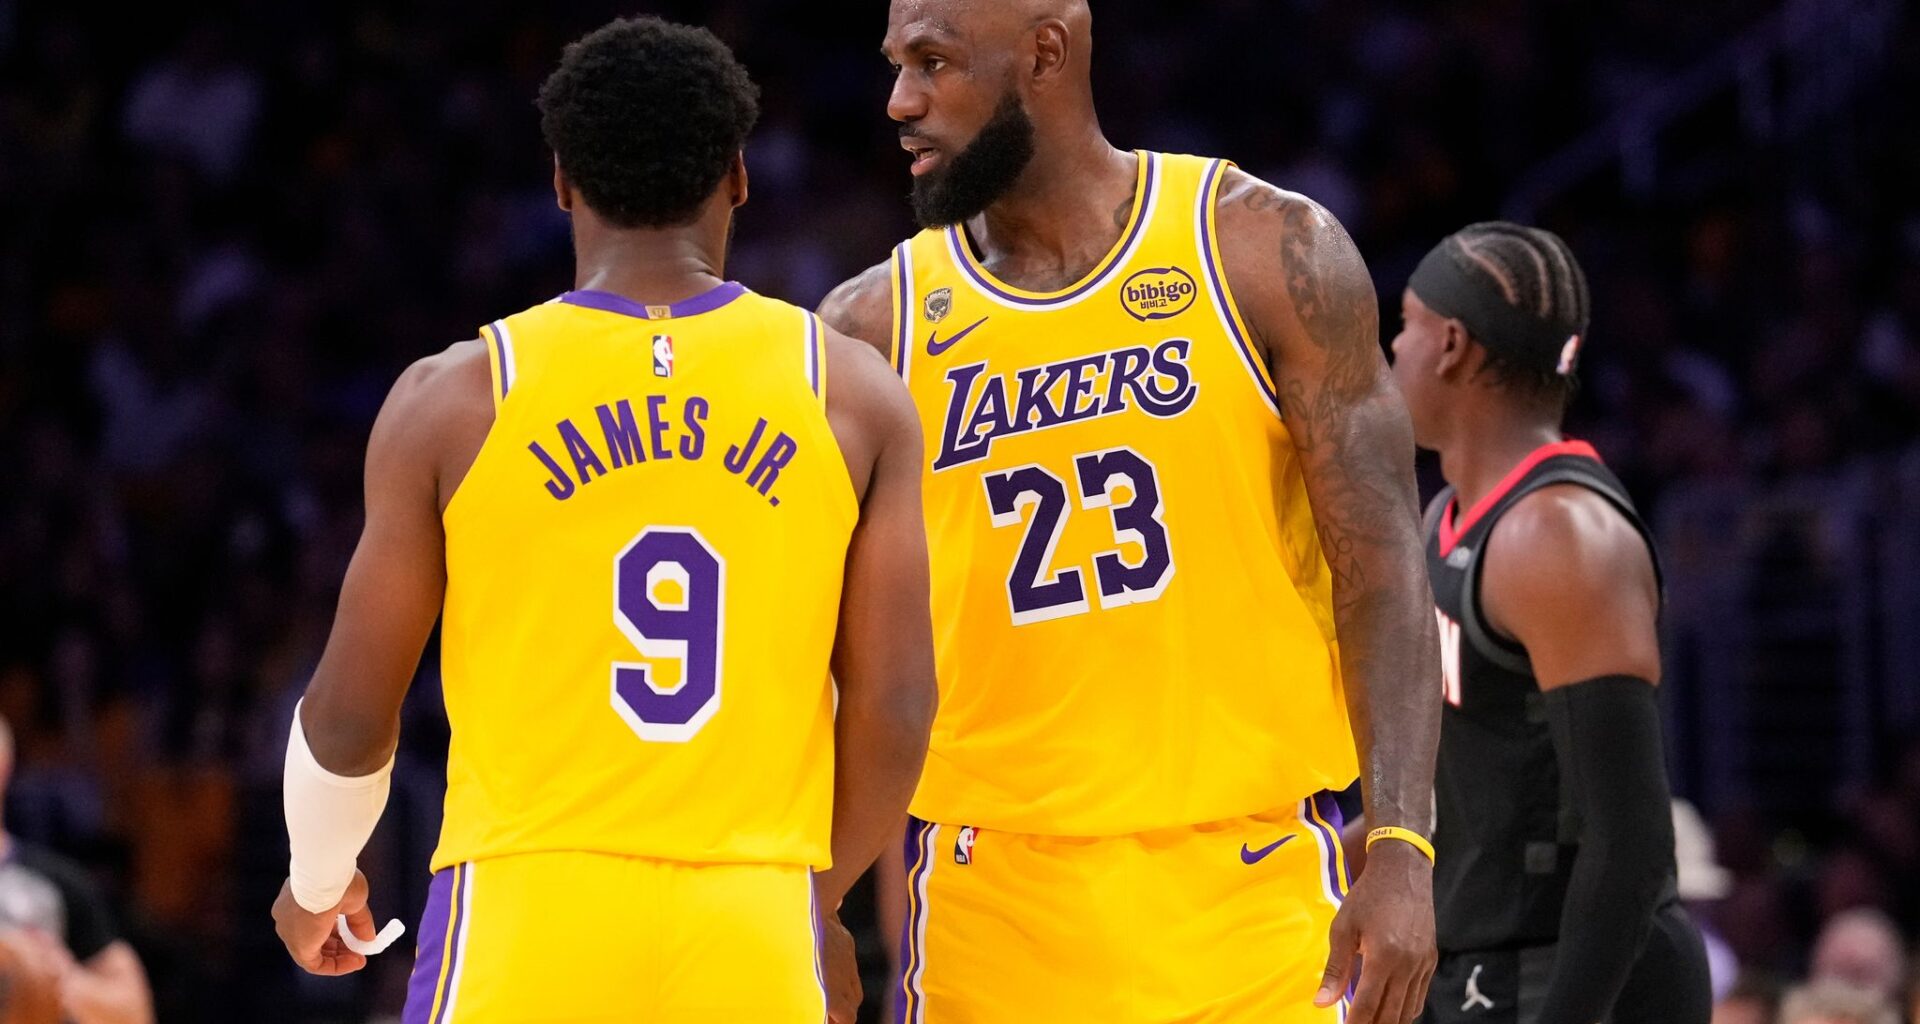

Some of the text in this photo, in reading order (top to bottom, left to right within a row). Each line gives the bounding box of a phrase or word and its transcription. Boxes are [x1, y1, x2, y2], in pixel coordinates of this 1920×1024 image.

[1126, 280, 1192, 302] bibigo
[1140, 299, 1168, 309] 비비고
[527, 395, 798, 508] JAMES JR.
[932, 337, 1200, 474] LAKERS
[980, 444, 1176, 627] 23
[609, 524, 726, 743] 9
